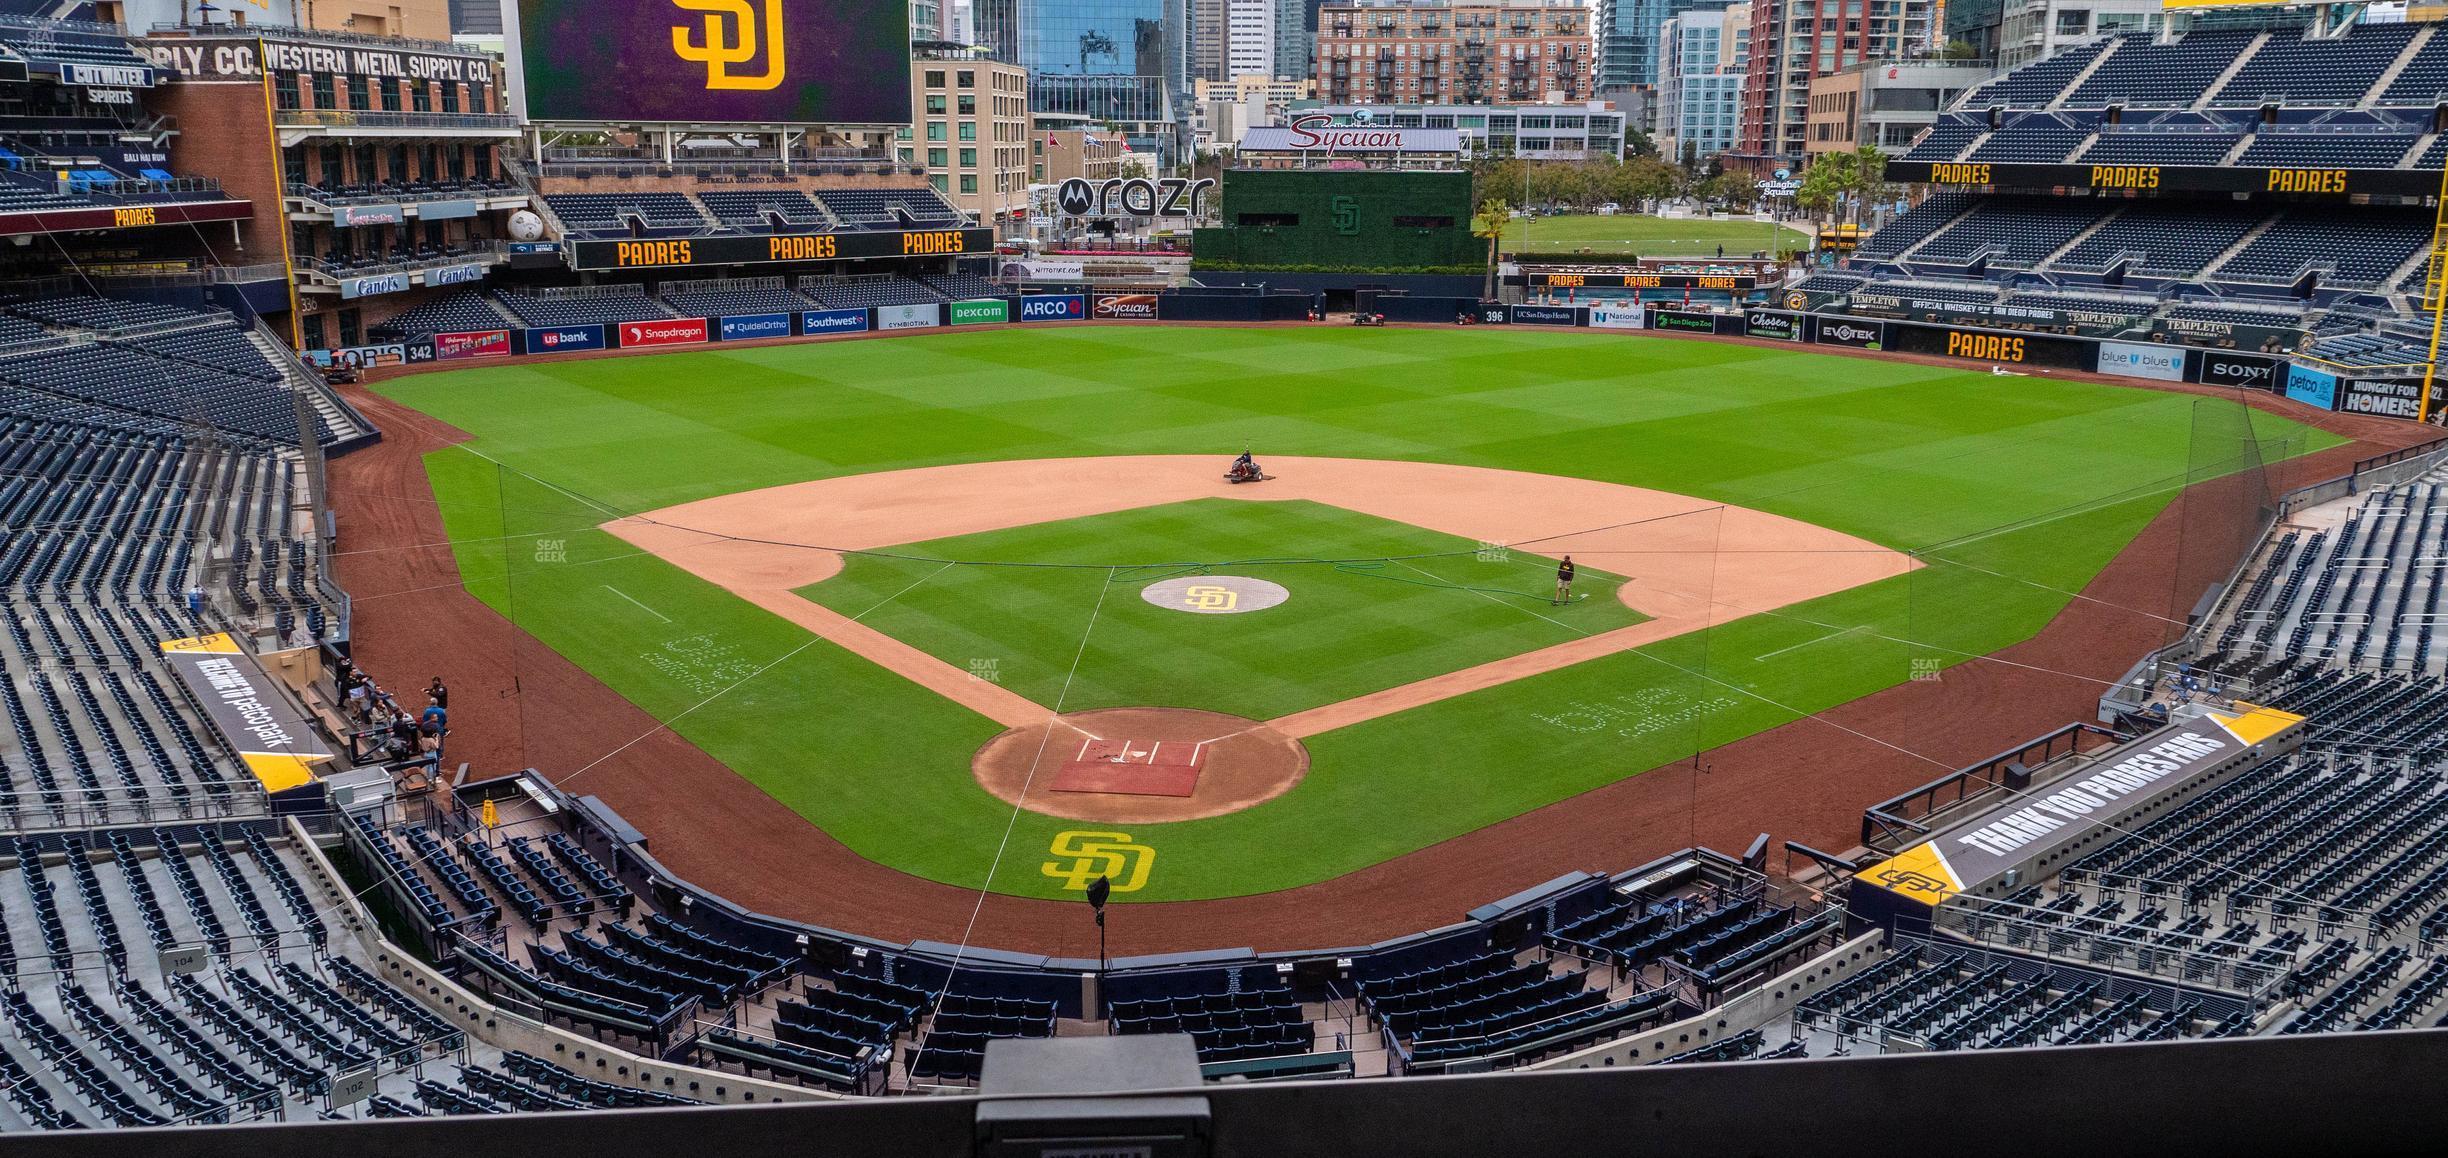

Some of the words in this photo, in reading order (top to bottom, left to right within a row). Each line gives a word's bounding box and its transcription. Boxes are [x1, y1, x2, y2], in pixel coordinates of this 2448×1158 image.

[264, 44, 347, 74] WESTERN
[354, 51, 406, 77] METAL
[409, 56, 461, 82] SUPPLY
[467, 60, 490, 83] CO.
[72, 65, 146, 86] CUTWATER
[89, 88, 133, 104] SPIRITS
[1288, 114, 1405, 158] Sycuan
[124, 153, 139, 162] BALI
[152, 153, 166, 162] RUM
[1932, 163, 1990, 185] PADRES
[2091, 165, 2160, 189] PADRES
[2268, 169, 2347, 193] PADRES
[1100, 177, 1216, 217] razr
[1763, 188, 1795, 197] Square
[114, 208, 156, 227] PADRES
[770, 235, 836, 260] PADRES
[903, 231, 963, 254] PADRES
[618, 240, 692, 266] PADRES
[437, 266, 474, 285] Canel's
[1548, 275, 1585, 286] PADRES
[1624, 276, 1660, 287] PADRES
[1698, 277, 1736, 289] PADRES
[356, 276, 399, 297] Canel's
[302, 297, 318, 312] 336
[1024, 301, 1067, 316] ARCO
[1097, 297, 1152, 318] Sycuan
[1851, 295, 1900, 308] TEMPLETON
[1912, 300, 1943, 311] OFFICIAL
[1944, 303, 1976, 313] WHISKEY
[1993, 306, 2007, 316] SAN
[2008, 308, 2027, 318] DIEGO
[2028, 310, 2054, 320] PADRES
[807, 315, 857, 328] Southwest
[889, 320, 929, 328] CYMBIOTIKA
[1486, 311, 1504, 322] 396
[1609, 312, 1640, 321] National
[1682, 319, 1699, 327] Diego
[1751, 313, 1790, 328] Chosen
[2067, 312, 2127, 327] TEMPLETON
[646, 326, 702, 340] Snapdragon
[737, 320, 787, 332] QuidelOrtho
[1823, 324, 1876, 341] EVOTEK
[2167, 320, 2232, 335] TEMPLETON
[544, 335, 558, 344] us
[560, 330, 588, 343] bank
[411, 345, 432, 360] 342
[1949, 331, 2024, 362] PADRES
[2101, 350, 2128, 364] blue
[2142, 353, 2169, 368] blue
[2213, 363, 2271, 380] SONY
[2290, 374, 2318, 393] petco
[2354, 380, 2396, 394] HUNGRY
[2397, 385, 2418, 398] FOR
[2346, 393, 2422, 418] HOMERS
[1184, 585, 1238, 611] SD
[195, 657, 250, 693] WELCOME
[224, 696, 273, 726] petco
[244, 722, 294, 749] park
[1958, 807, 2068, 857] THANK
[2032, 787, 2107, 821] YOU
[2076, 753, 2182, 801] PADRES
[2148, 732, 2226, 765] FANS
[1041, 831, 1156, 892] SD
[175, 957, 193, 966] 104
[346, 1081, 364, 1095] 102
